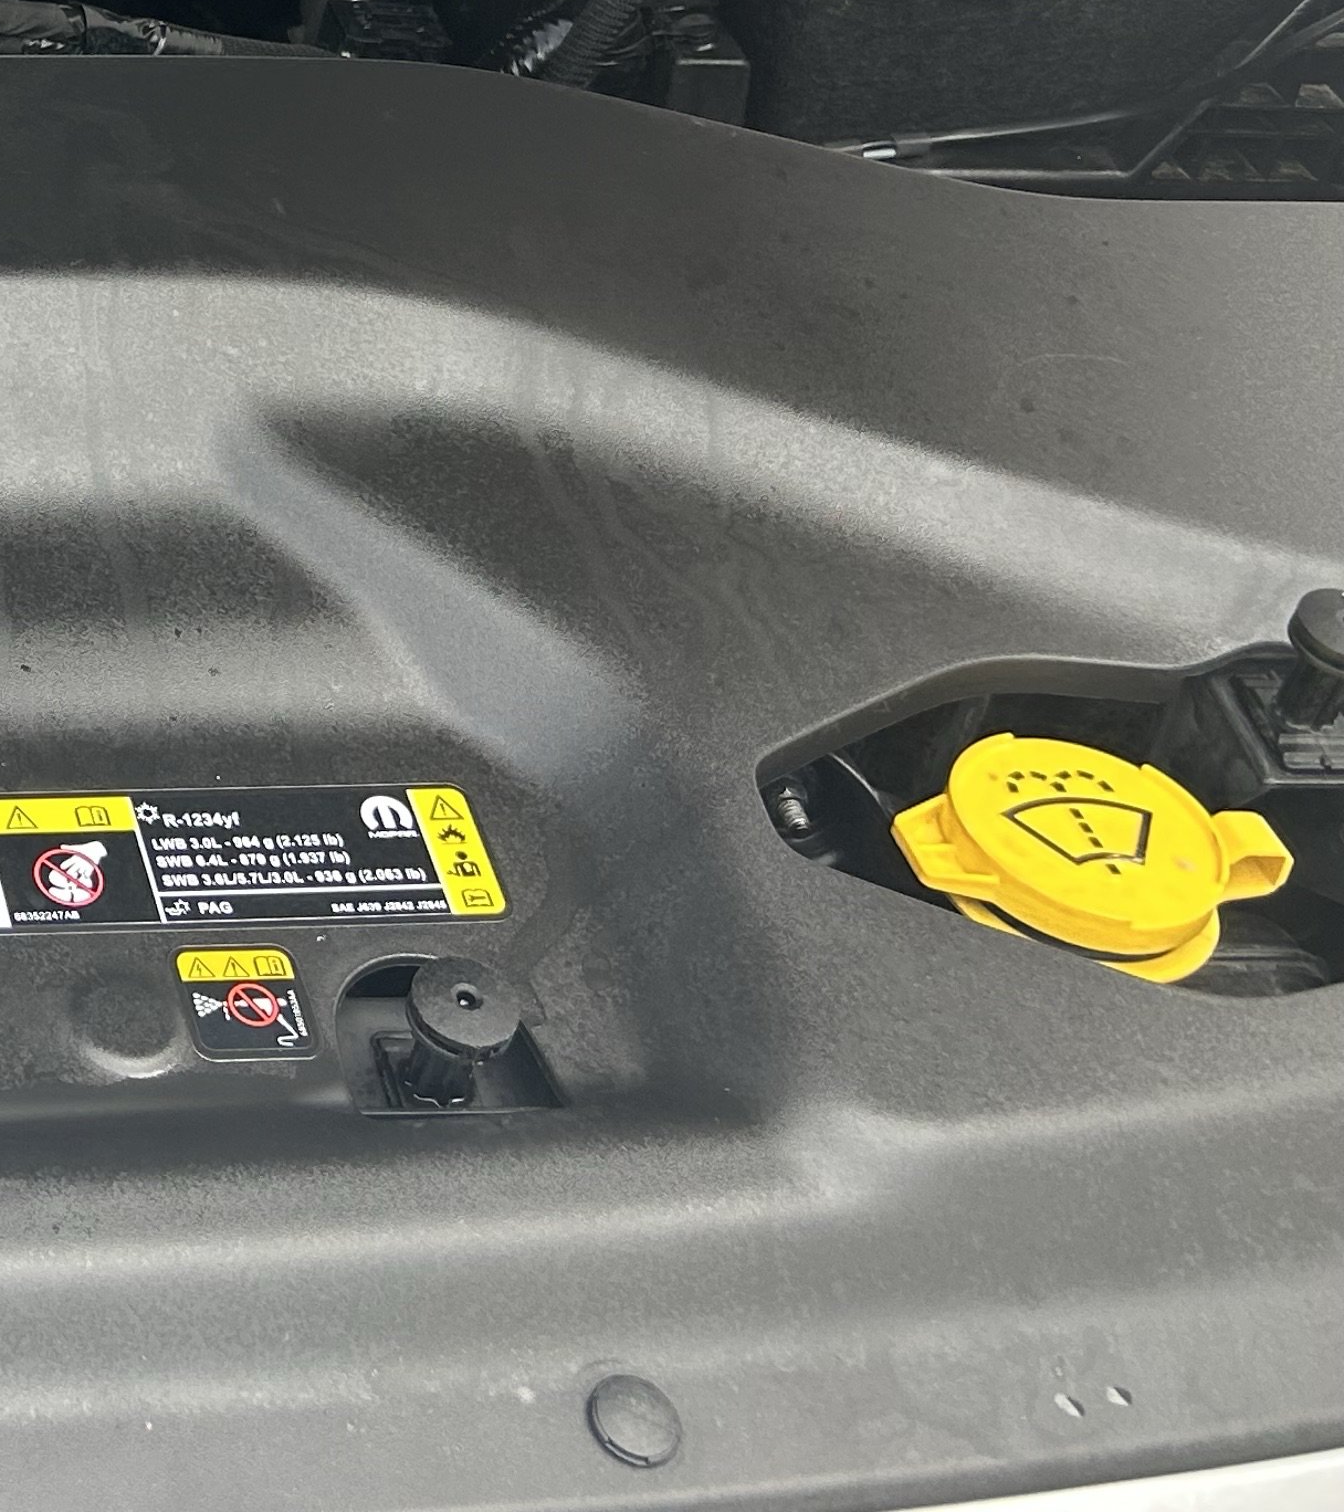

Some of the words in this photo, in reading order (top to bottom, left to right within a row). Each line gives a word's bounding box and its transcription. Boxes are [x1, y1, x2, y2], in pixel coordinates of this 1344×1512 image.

[162, 811, 240, 829] R-1234yf
[152, 838, 187, 850] LWB
[190, 837, 222, 849] 3.0L
[263, 838, 274, 850] g
[277, 834, 320, 849] (2.125
[323, 833, 344, 848] lb)
[368, 830, 419, 839] MOPAR
[156, 855, 193, 868] SWB
[270, 855, 281, 868] g
[329, 850, 350, 865] lb)
[162, 874, 199, 887] SWB
[346, 873, 357, 885] g
[405, 867, 426, 882] lb)
[198, 901, 233, 915] PAG
[331, 903, 355, 912] SAE
